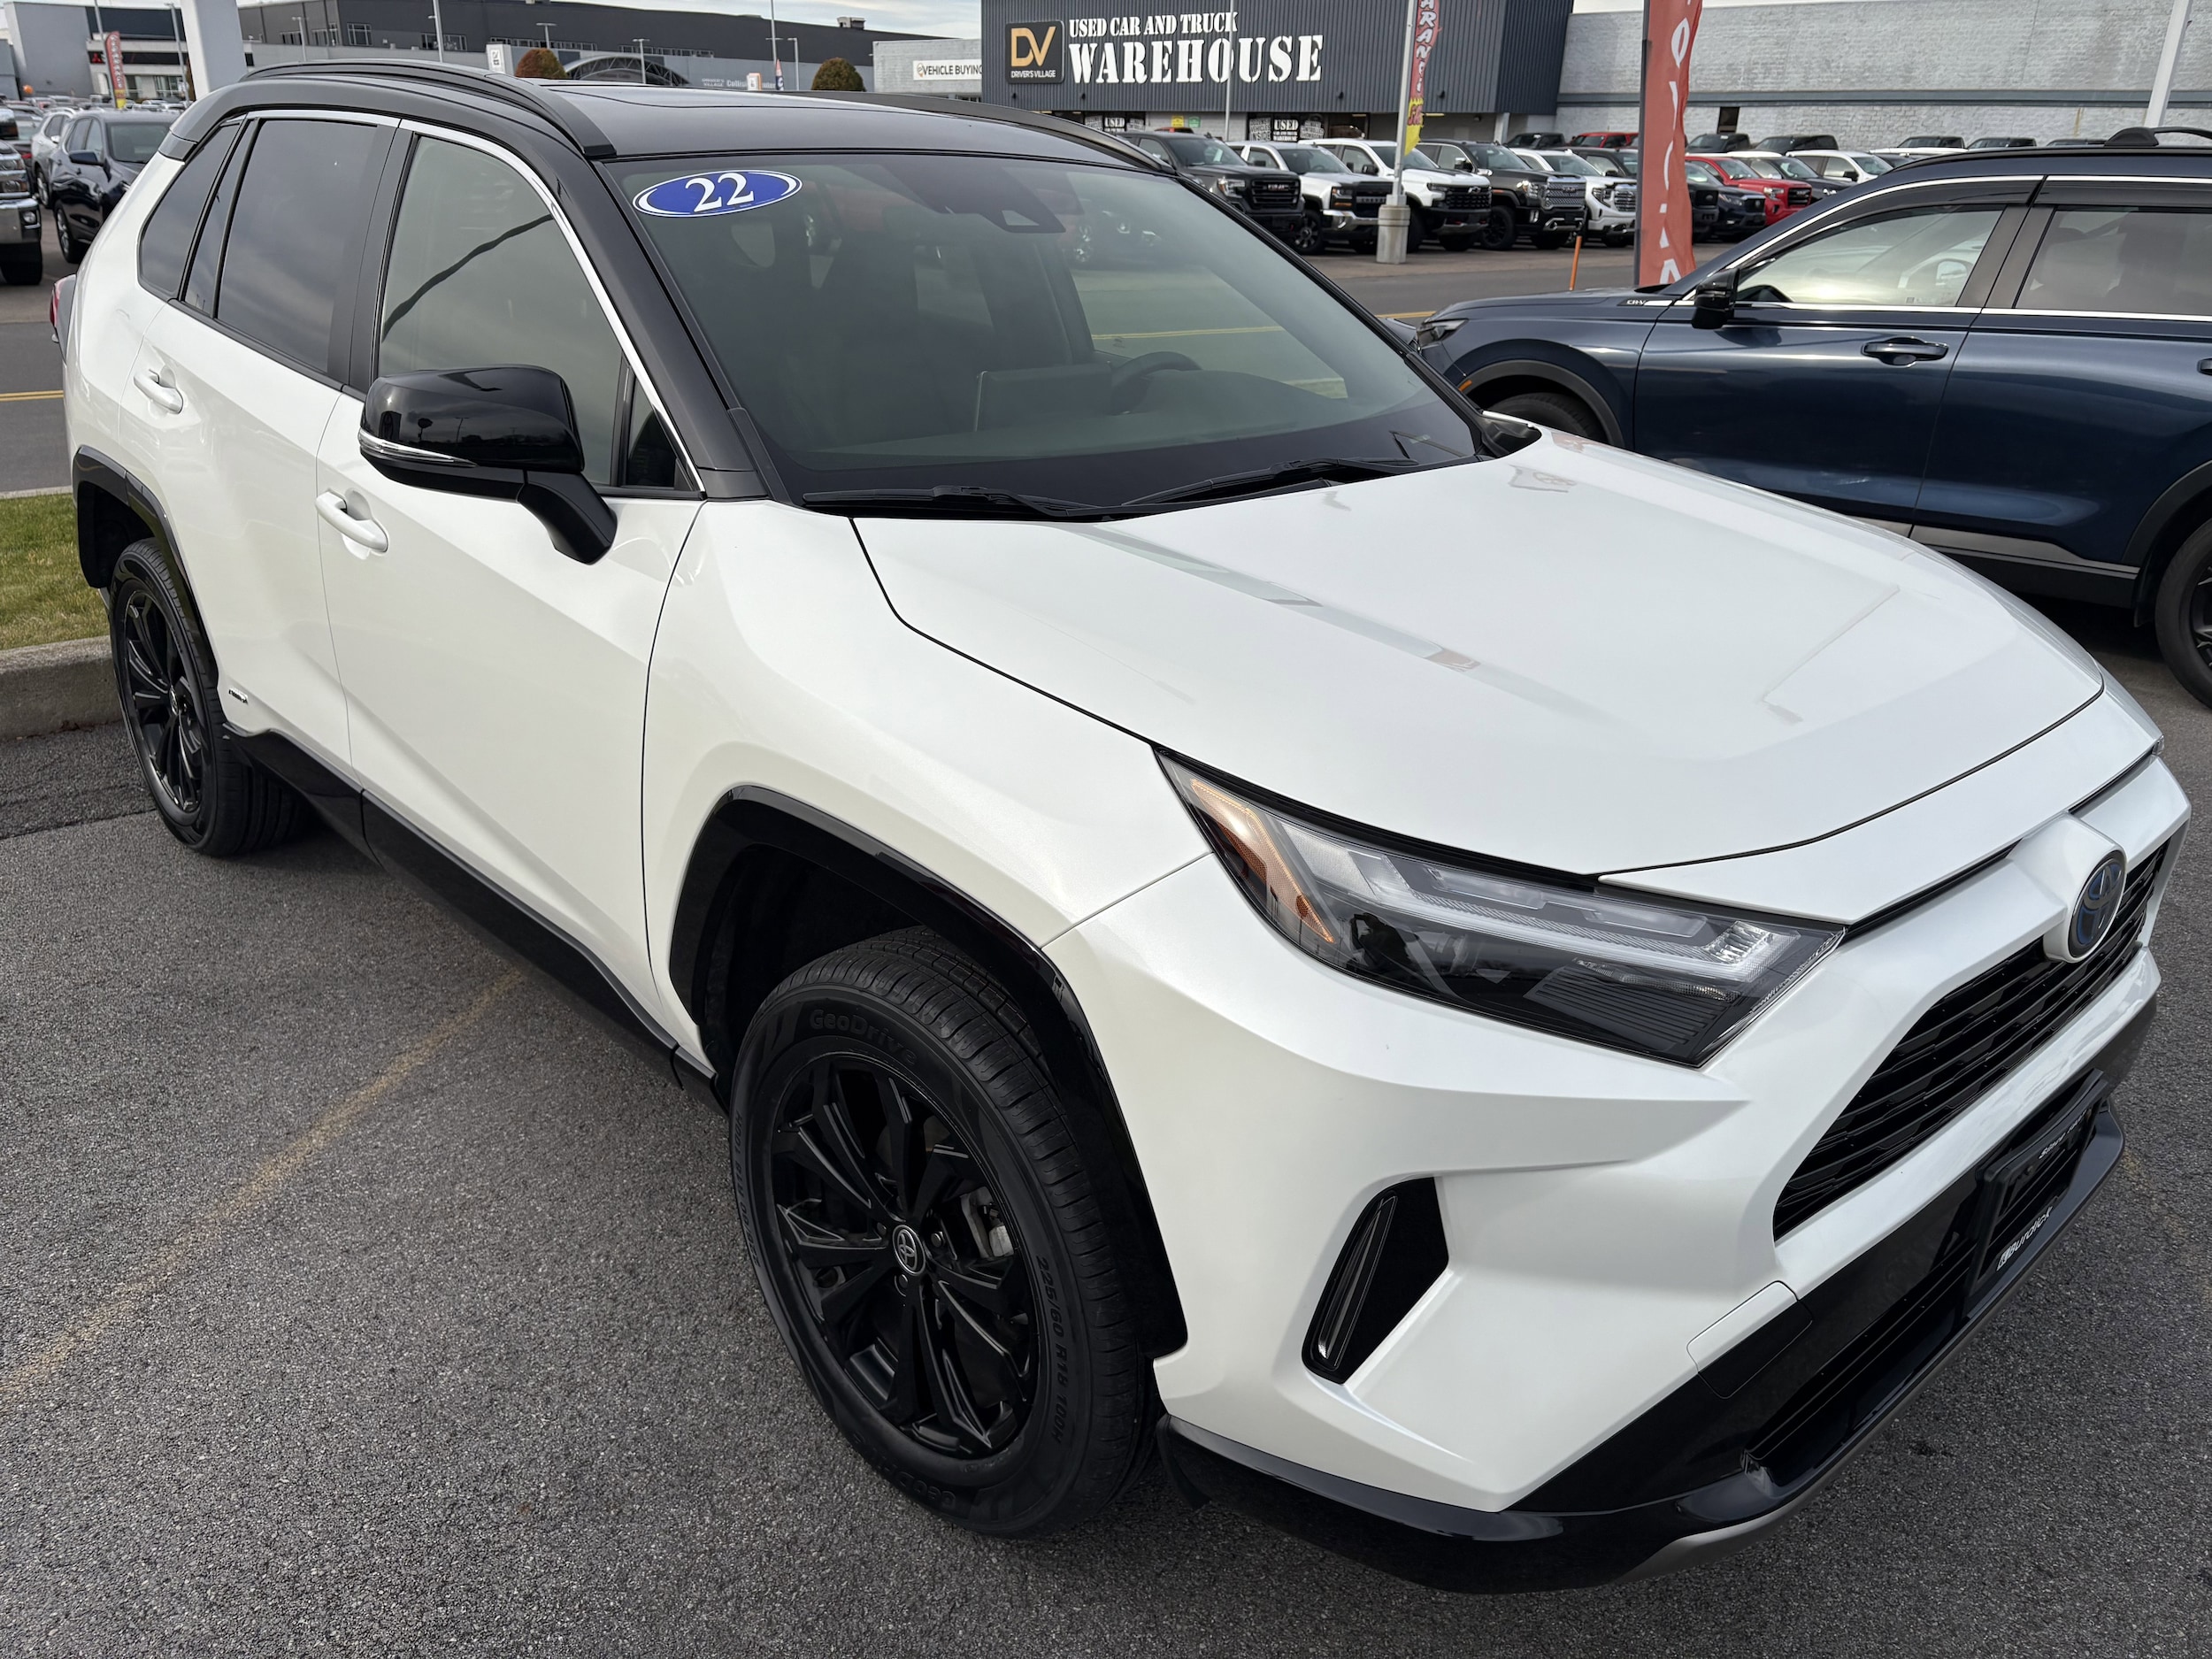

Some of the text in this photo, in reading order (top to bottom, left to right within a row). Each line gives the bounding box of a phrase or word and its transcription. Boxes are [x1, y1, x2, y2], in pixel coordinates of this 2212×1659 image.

[1069, 12, 1238, 38] USED CAR AND TRUCK
[1010, 26, 1056, 67] DV
[1068, 35, 1324, 84] WAREHOUSE
[922, 65, 954, 75] VEHICLE
[1104, 117, 1125, 127] USED
[1250, 132, 1271, 142] INSIDE
[1274, 119, 1299, 130] USED
[685, 173, 755, 212] 22
[809, 1009, 918, 1065] GeoDrive
[2006, 1206, 2053, 1261] Burdick
[1036, 1255, 1068, 1445] 225/60 R18 100H
